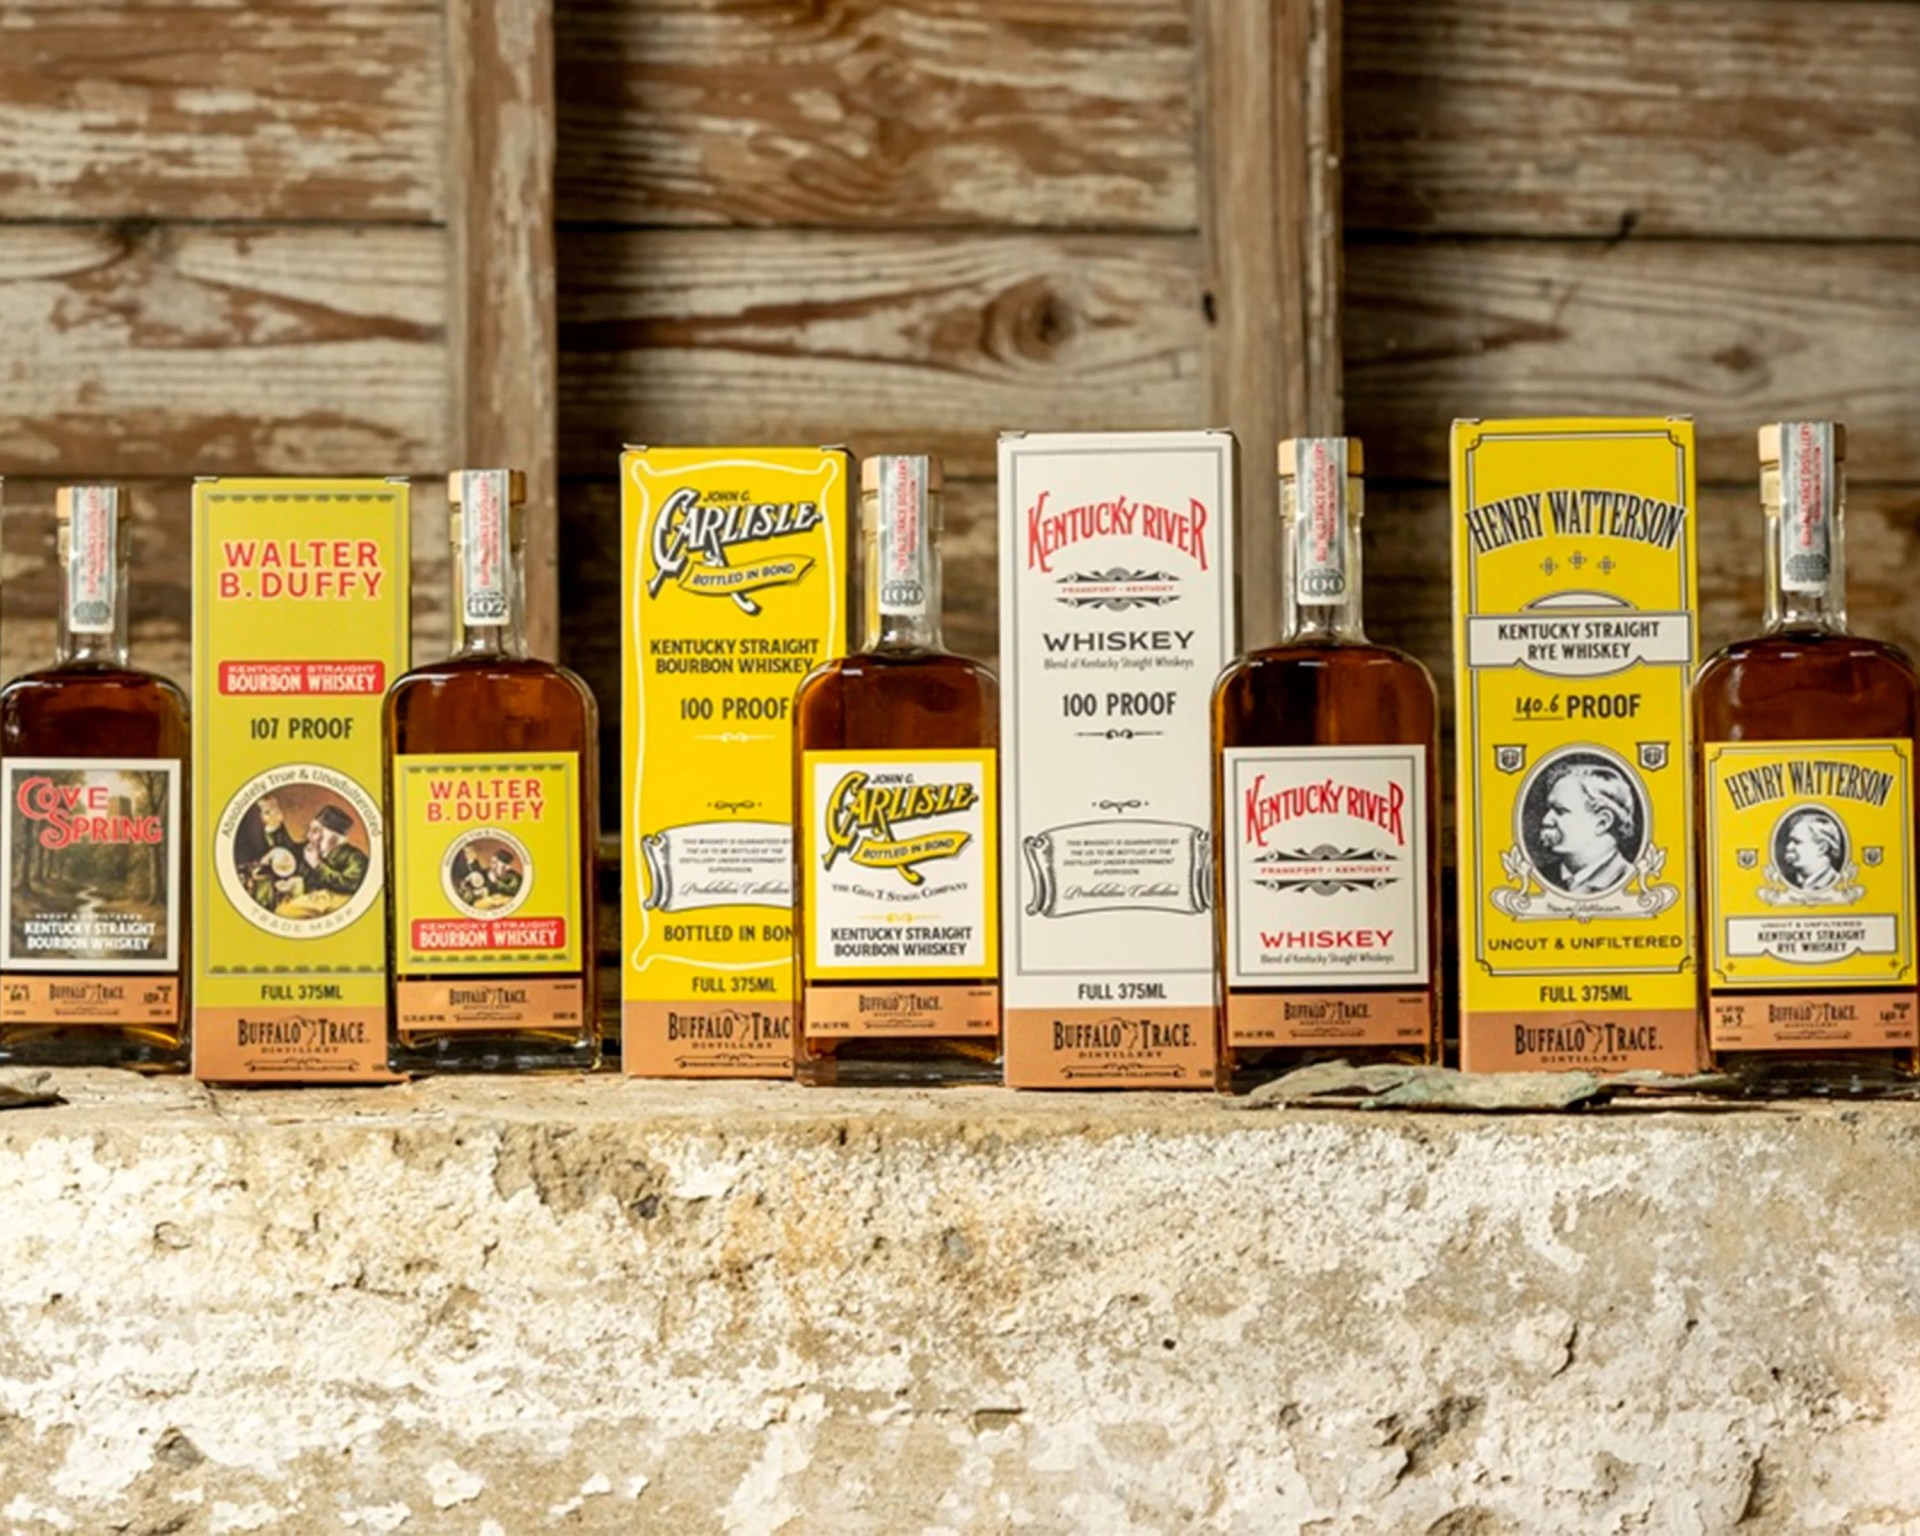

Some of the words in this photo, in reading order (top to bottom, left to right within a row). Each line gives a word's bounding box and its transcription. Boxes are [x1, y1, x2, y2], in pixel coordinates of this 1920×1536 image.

[704, 490, 738, 502] JOHN
[1465, 492, 1543, 553] HENRY
[1547, 490, 1686, 550] WATTERSON
[650, 486, 824, 588] CARLISLE
[1028, 490, 1139, 573] KENTUCKY
[1142, 497, 1208, 571] RIVER
[223, 541, 379, 567] WALTER
[692, 570, 743, 587] BOTTLED
[746, 570, 760, 580] IN
[762, 564, 796, 577] BOND
[1303, 578, 1344, 592] 100
[1498, 622, 1580, 640] KENTUCKY
[1585, 621, 1660, 638] STRAIGHT
[650, 639, 736, 655] KENTUCKY
[740, 638, 819, 654] STRAIGHT
[1043, 631, 1194, 651] WHISKEY
[1528, 644, 1557, 660] RYE
[1561, 643, 1631, 660] WHISKEY
[228, 665, 301, 674] KENTUCKY
[306, 665, 376, 673] STRAIGHT
[656, 658, 733, 674] BOURBON
[737, 658, 813, 673] WHISKEY
[1044, 657, 1068, 669] Blend
[1081, 658, 1119, 672] Kentucky
[1155, 656, 1194, 670] Whiskeys
[227, 674, 301, 692] BOURBON
[307, 674, 376, 691] WHISKEY
[681, 698, 713, 720] 100
[722, 697, 789, 720] PROOF
[1063, 693, 1097, 717] 100
[1107, 692, 1177, 716] PROOF
[1515, 694, 1560, 719] 140.6
[1566, 694, 1641, 718] PROOF
[251, 717, 279, 739] 107
[289, 717, 353, 739] PROOF
[872, 774, 903, 784] JOHN
[1724, 763, 1785, 810] HENRY
[1788, 761, 1894, 807] WATTERSON
[430, 779, 541, 799] WALTER
[16, 776, 109, 821] COVE
[825, 770, 979, 860] CARLISLE
[1245, 774, 1344, 847] KENTUCKY
[1347, 780, 1405, 846] RIVER
[39, 807, 163, 849] SPRING
[863, 847, 909, 859] BOTTLED
[911, 846, 923, 854] IN
[1261, 866, 1323, 875] FRANKFORT
[1335, 865, 1391, 874] KENTUCKY
[24, 922, 90, 934] KENTUCKY
[93, 922, 156, 934] STRAIGHT
[664, 925, 733, 942] BOTTLED
[740, 925, 755, 941] IN
[763, 925, 794, 941] BON
[831, 928, 902, 941] KENTUCKY
[905, 927, 972, 940] STRAIGHT
[1758, 931, 1812, 941] KENTUCKY
[1817, 930, 1865, 940] STRAIGHT
[27, 937, 88, 949] BOURBON
[91, 936, 151, 949] WHISKEY
[420, 931, 487, 948] BOURBON
[493, 929, 557, 946] WHISKEY
[1260, 930, 1394, 948] WHISKEY
[1488, 937, 1548, 950] UNCUT
[1554, 936, 1565, 949] &
[1570, 934, 1683, 949] UNFILTERED
[1777, 943, 1795, 952] RYE
[1802, 942, 1847, 952] WHISKEY
[834, 944, 899, 957] BOURBON
[903, 943, 966, 956] WHISKEY
[49, 984, 87, 1000] BUFFALO
[261, 985, 294, 999] FULL
[298, 985, 342, 999] 375ML
[692, 977, 725, 992] FULL
[731, 976, 777, 992] 375ML
[1079, 983, 1113, 999] FULL
[1118, 983, 1167, 999] 375ML
[449, 988, 487, 1006] BUFFALO
[498, 987, 526, 1004] TRACE
[859, 994, 899, 1012] BUFFALO
[910, 993, 940, 1011] TRACE
[1540, 986, 1576, 1002] FULL
[1582, 985, 1632, 1001] 375ML
[1284, 1001, 1326, 1020] BUFFALO
[1336, 1001, 1369, 1019] TRACE
[1769, 1004, 1811, 1023] BUFFALO
[1824, 1003, 1855, 1020] TRACE
[238, 1018, 300, 1046] BUFFALO
[318, 1018, 365, 1045] TRACE
[668, 1012, 733, 1040] BUFFALO
[752, 1012, 790, 1040] TRAC
[1053, 1021, 1121, 1050] BUFFALO
[1140, 1020, 1191, 1049] TRACE
[1515, 1024, 1585, 1055] BUFFALO
[1605, 1023, 1658, 1052] TRACE
[1078, 1051, 1162, 1059] DISTILLERY
[1541, 1055, 1628, 1063] DISTILLERY
